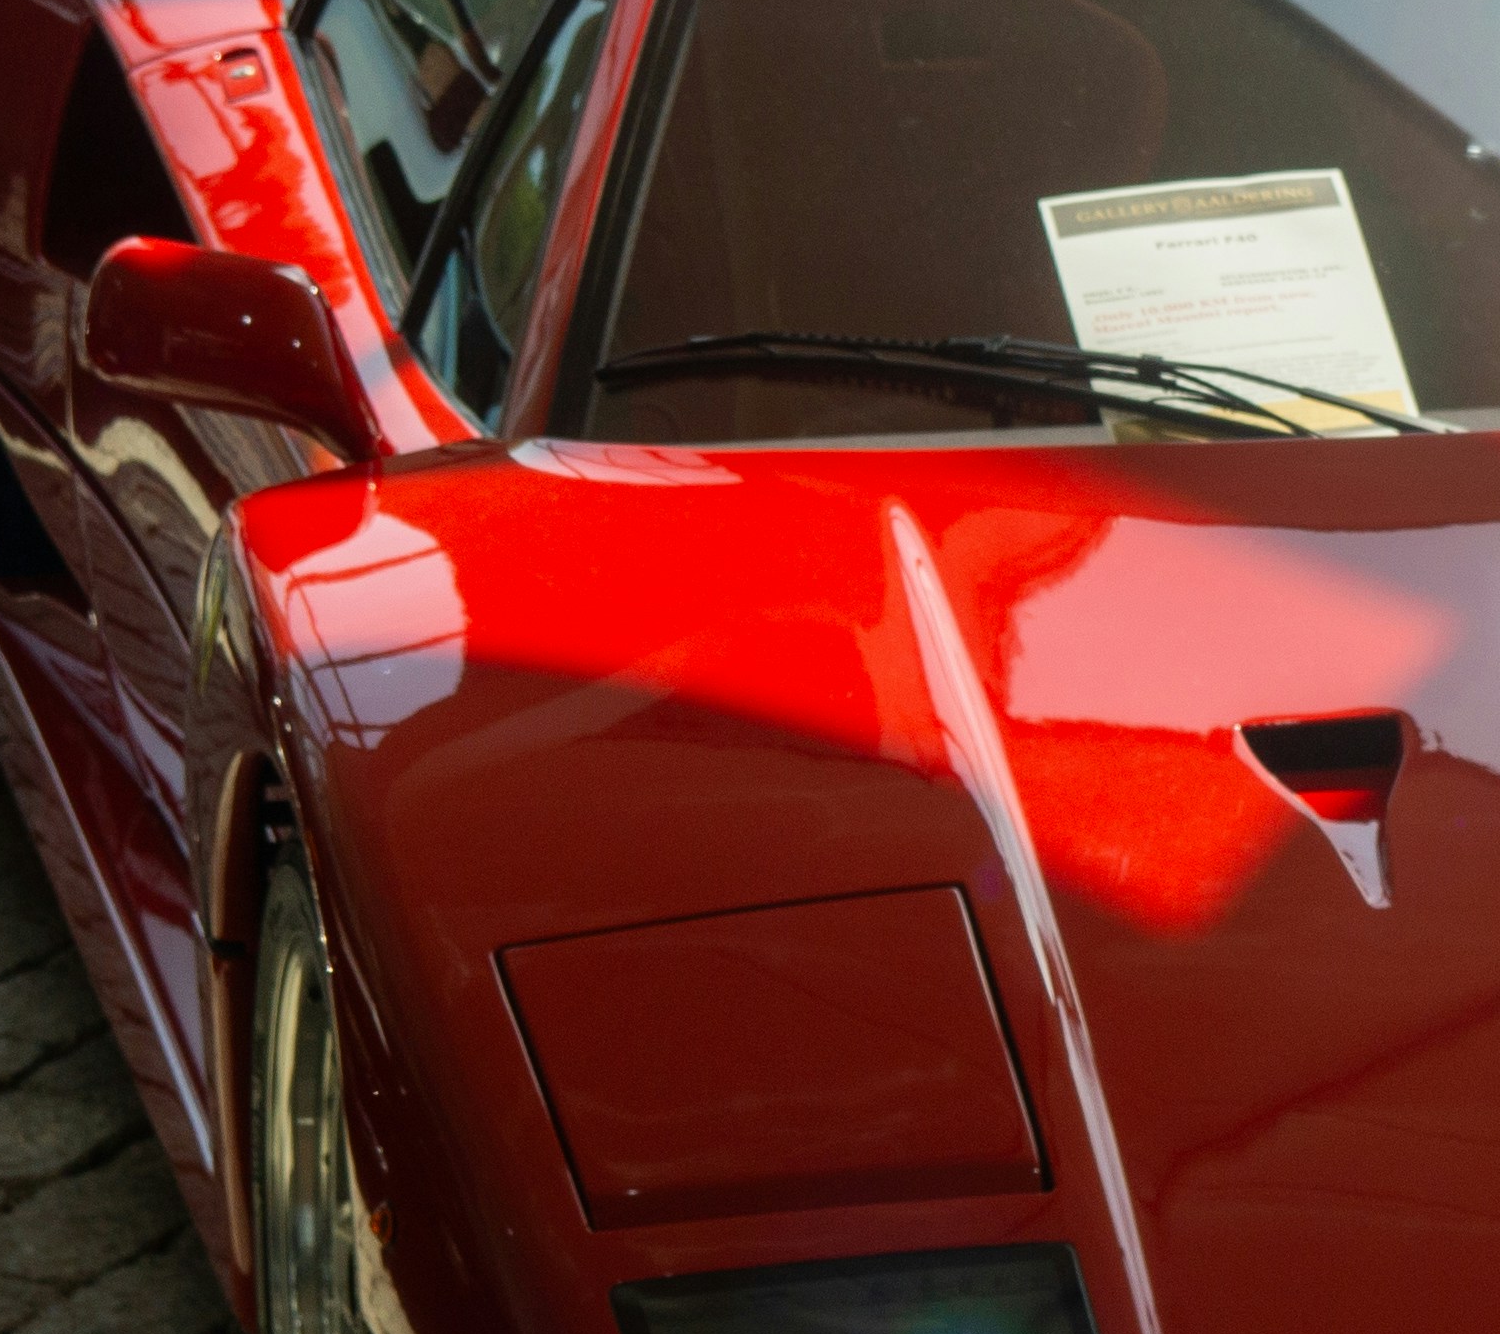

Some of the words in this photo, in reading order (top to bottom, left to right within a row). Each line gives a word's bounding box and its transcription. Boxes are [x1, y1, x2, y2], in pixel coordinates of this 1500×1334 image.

[1075, 198, 1169, 223] GALLERY
[1193, 186, 1314, 209] AALDERING
[1155, 236, 1218, 251] Ferrari
[1223, 232, 1258, 245] F40
[1233, 292, 1272, 305] from
